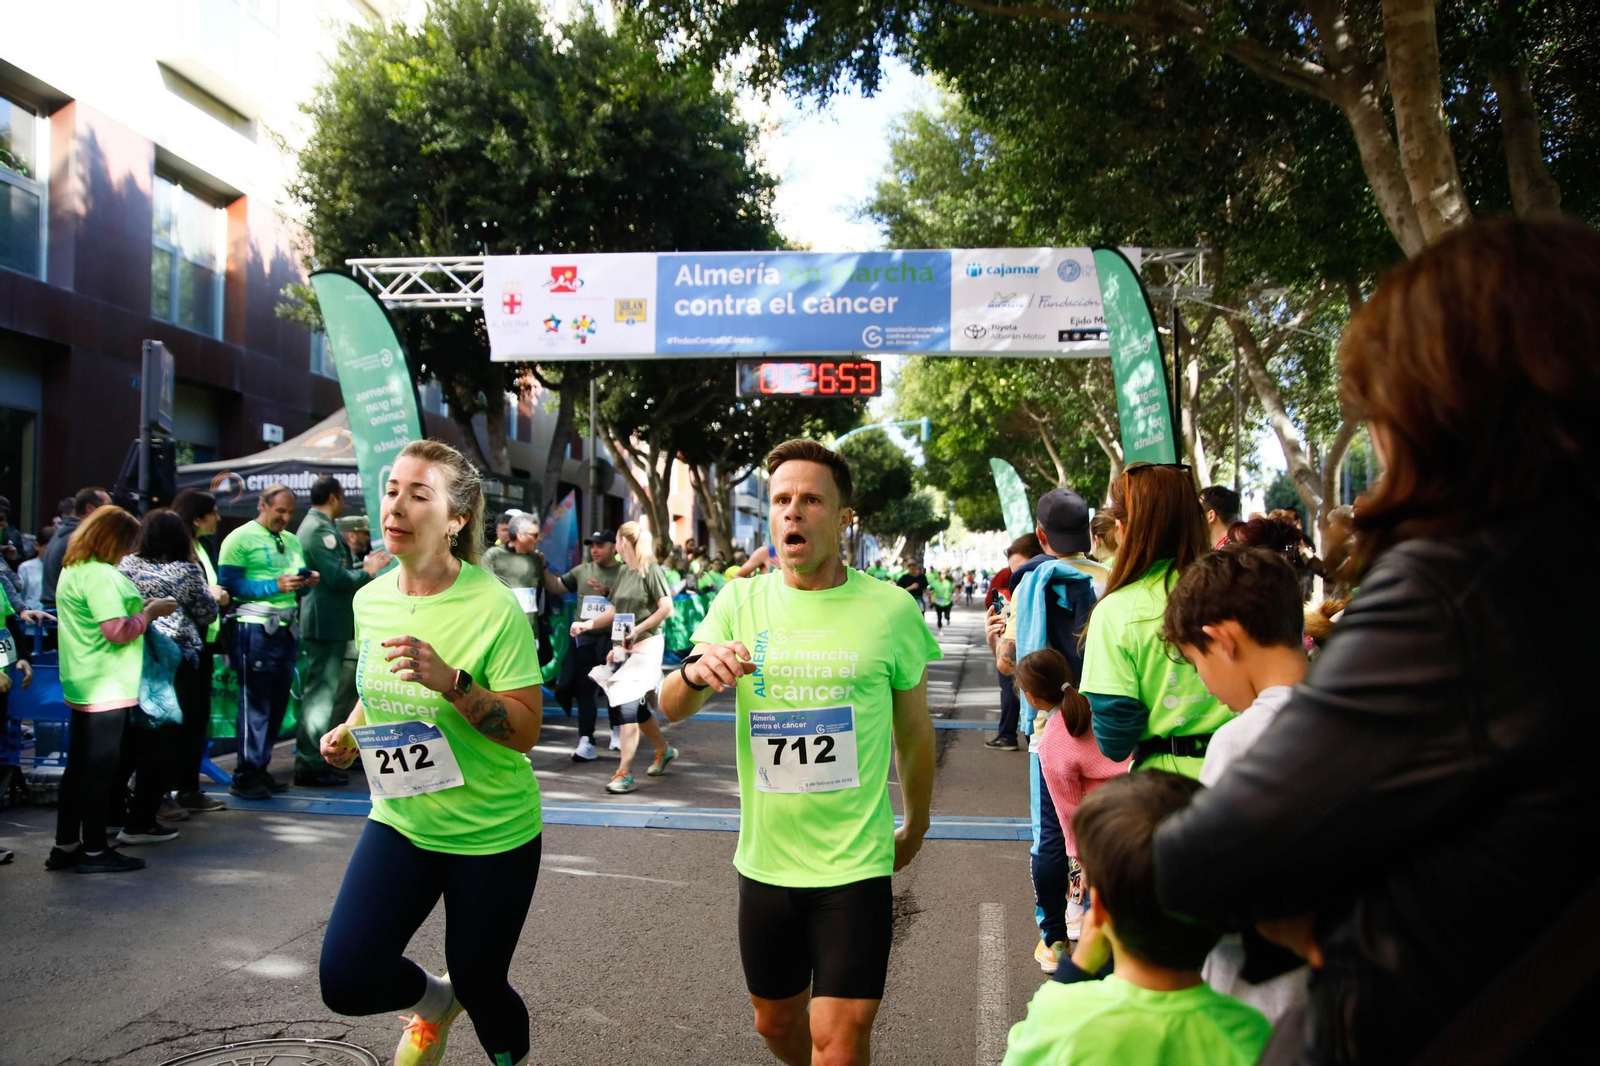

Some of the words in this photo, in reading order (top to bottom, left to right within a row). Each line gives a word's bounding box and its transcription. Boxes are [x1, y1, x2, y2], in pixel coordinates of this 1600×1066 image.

[674, 262, 780, 286] Almería
[788, 267, 820, 283] en
[830, 260, 934, 283] marcha
[986, 263, 1040, 276] cajamar
[674, 294, 763, 316] contra
[769, 292, 796, 315] el
[802, 292, 898, 314] cáncer
[1038, 295, 1100, 308] Fundación
[991, 324, 1017, 332] Toyota
[1070, 316, 1091, 326] Ejido
[246, 470, 319, 490] cruzando
[587, 604, 606, 612] 846
[752, 629, 768, 698] ALMERÍA
[770, 648, 789, 660] En
[795, 648, 858, 661] marcha
[367, 660, 383, 675] En
[769, 663, 832, 678] contra
[839, 663, 857, 678] el
[365, 678, 416, 698] contra
[770, 680, 854, 701] cáncer
[368, 694, 440, 719] cáncer
[375, 744, 435, 774] 212
[767, 736, 836, 765] 712
